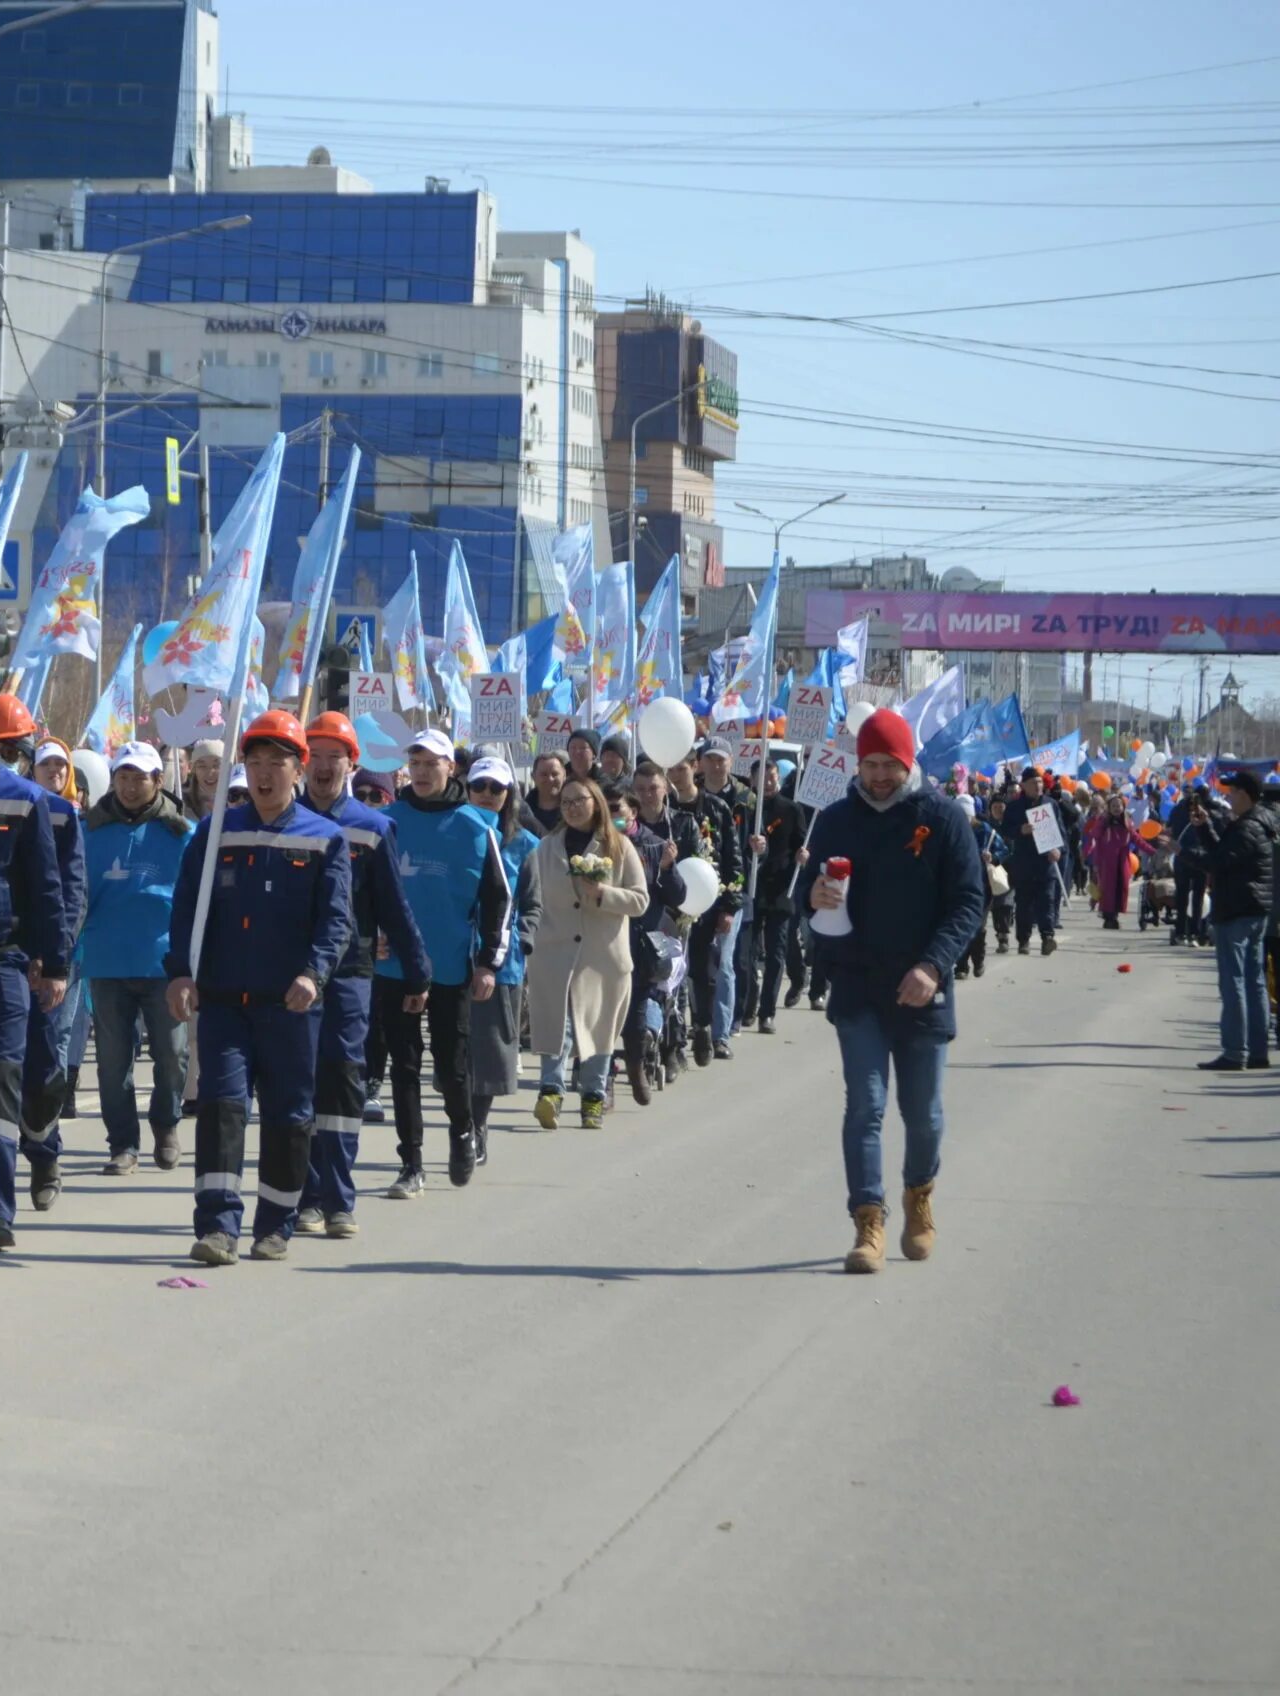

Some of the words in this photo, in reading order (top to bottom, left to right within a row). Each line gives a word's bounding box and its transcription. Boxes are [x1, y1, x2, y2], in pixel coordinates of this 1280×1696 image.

[205, 318, 274, 333] АЛМАЗЫ
[314, 318, 387, 333] АНАБАРА
[948, 613, 1020, 633] МИР!
[1077, 614, 1160, 637] ТРУД!
[357, 676, 385, 694] ZA
[480, 677, 513, 696] ZA
[797, 687, 825, 707] ZA
[480, 701, 514, 712] МИР
[480, 712, 512, 723] ТРУД
[480, 723, 512, 735] МАЙ
[818, 749, 846, 773] ZA
[812, 768, 844, 785] МИР
